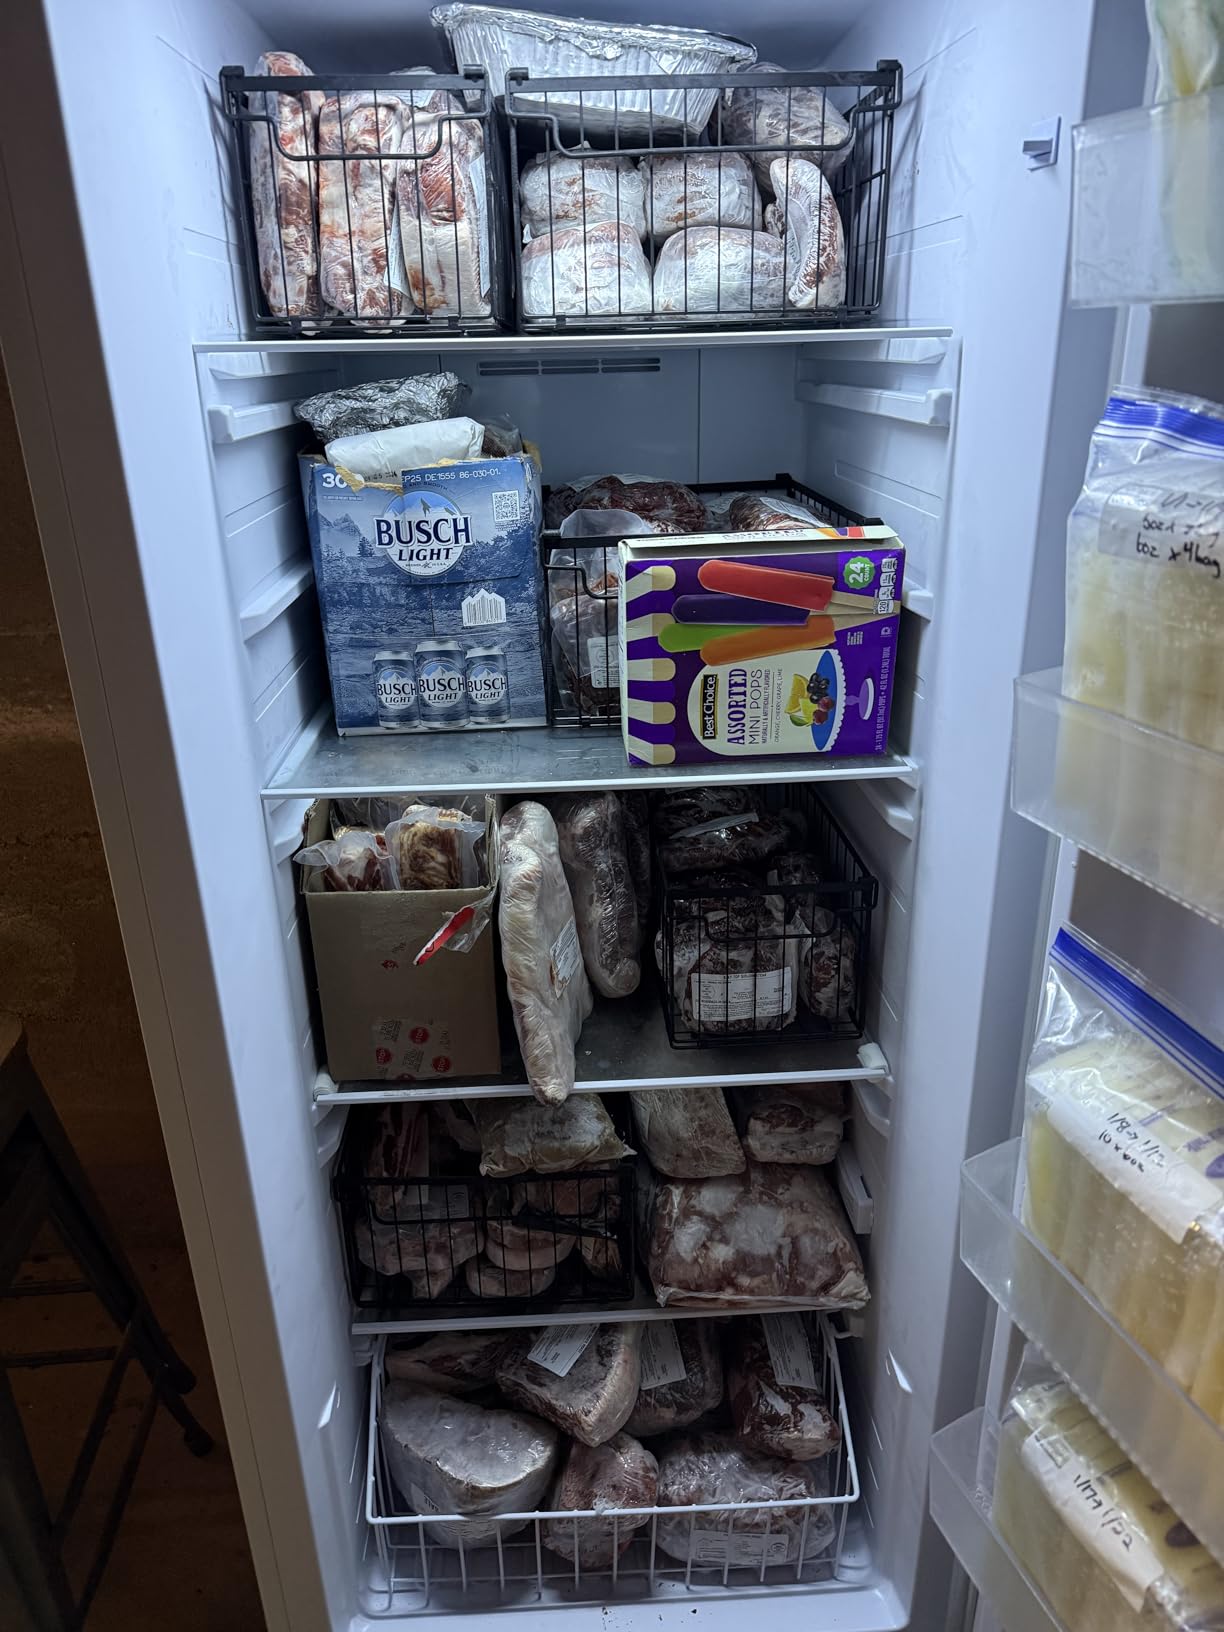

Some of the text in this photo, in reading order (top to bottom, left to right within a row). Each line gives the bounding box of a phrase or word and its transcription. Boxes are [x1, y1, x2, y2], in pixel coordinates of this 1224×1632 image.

[425, 472, 456, 481] DE1555
[375, 516, 472, 546] BUSCH
[398, 547, 454, 561] LIGHT
[848, 561, 865, 584] 24
[864, 562, 872, 583] COUNT
[377, 683, 417, 696] BUSCH
[419, 677, 466, 693] BUSCH
[467, 677, 507, 693] BUSCH
[385, 696, 411, 704] LIGHT
[428, 692, 458, 701] LIGHT
[475, 691, 501, 700] LIGHT
[727, 668, 747, 745] ASSORTED
[749, 669, 762, 744] MINI POPS
[704, 715, 715, 737] Best
